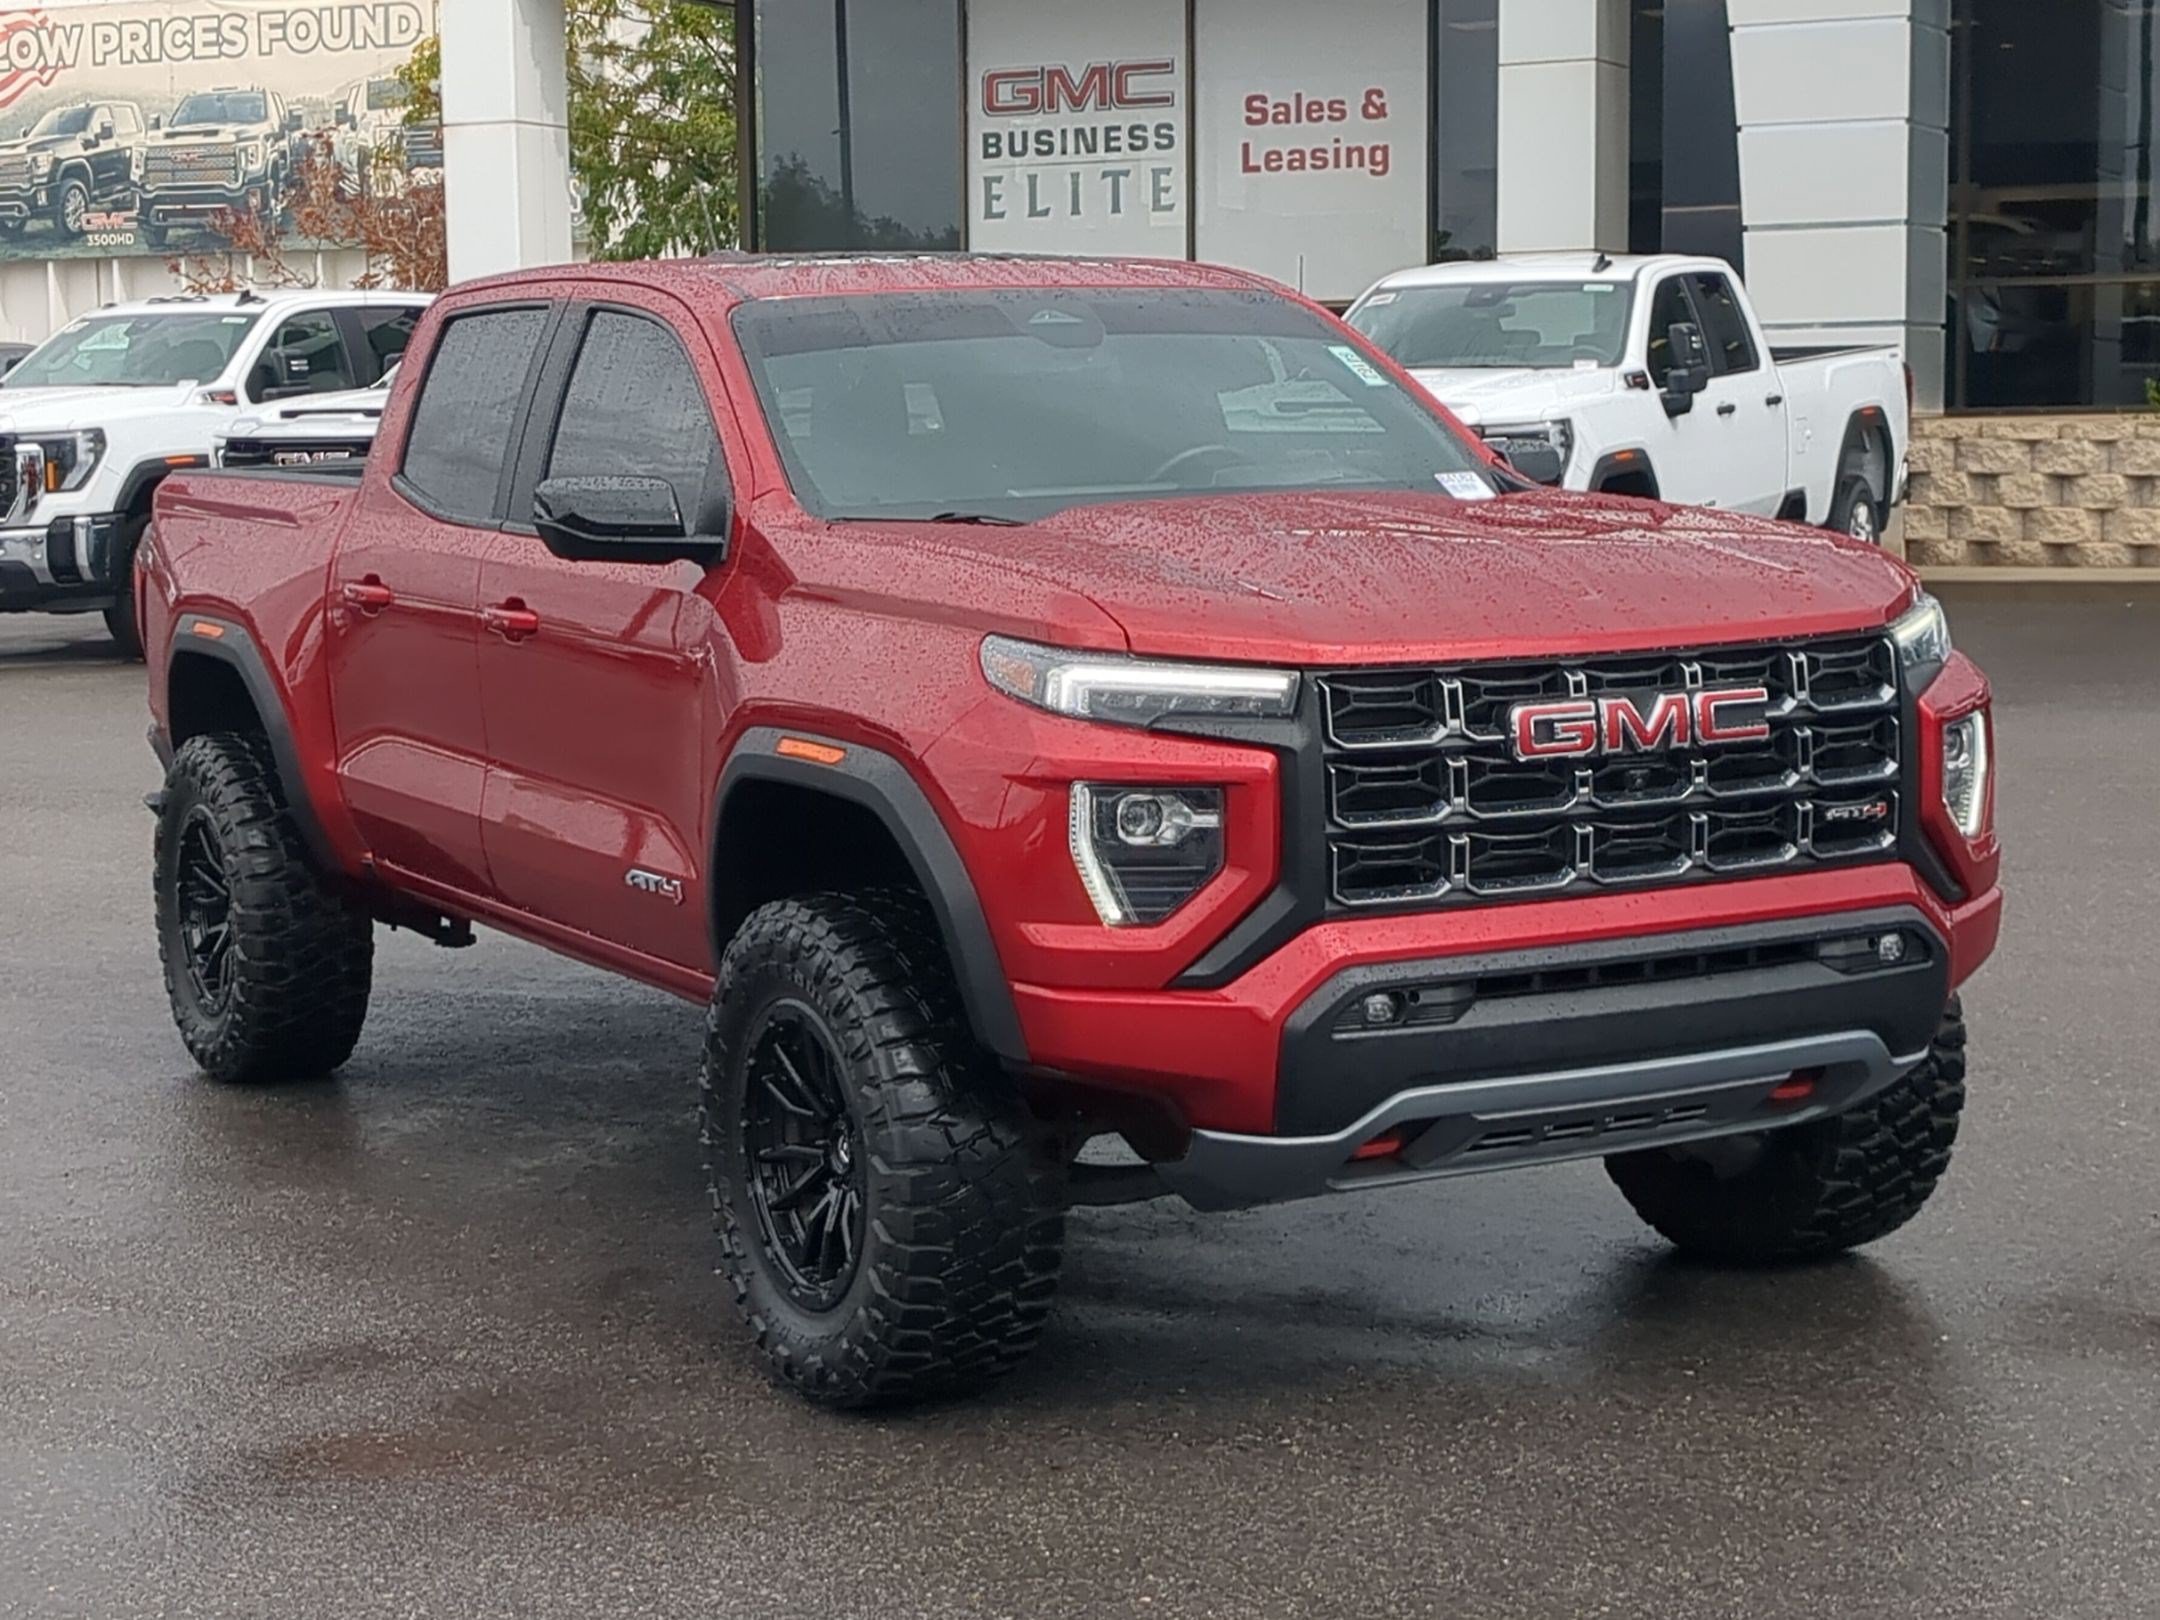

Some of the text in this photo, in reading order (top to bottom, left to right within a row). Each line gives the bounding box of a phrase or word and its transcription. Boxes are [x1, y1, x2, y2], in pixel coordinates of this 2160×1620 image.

[0, 24, 84, 73] OW
[92, 13, 248, 66] PRICES
[258, 2, 422, 56] FOUND
[981, 57, 1175, 118] GMC
[1243, 88, 1388, 127] Sales &
[981, 122, 1176, 160] BUSINESS
[1241, 138, 1390, 176] Leasing
[982, 166, 1176, 221] ELITE
[80, 211, 138, 231] GMC
[86, 233, 134, 247] 3500HD
[1510, 685, 1770, 761] GMC
